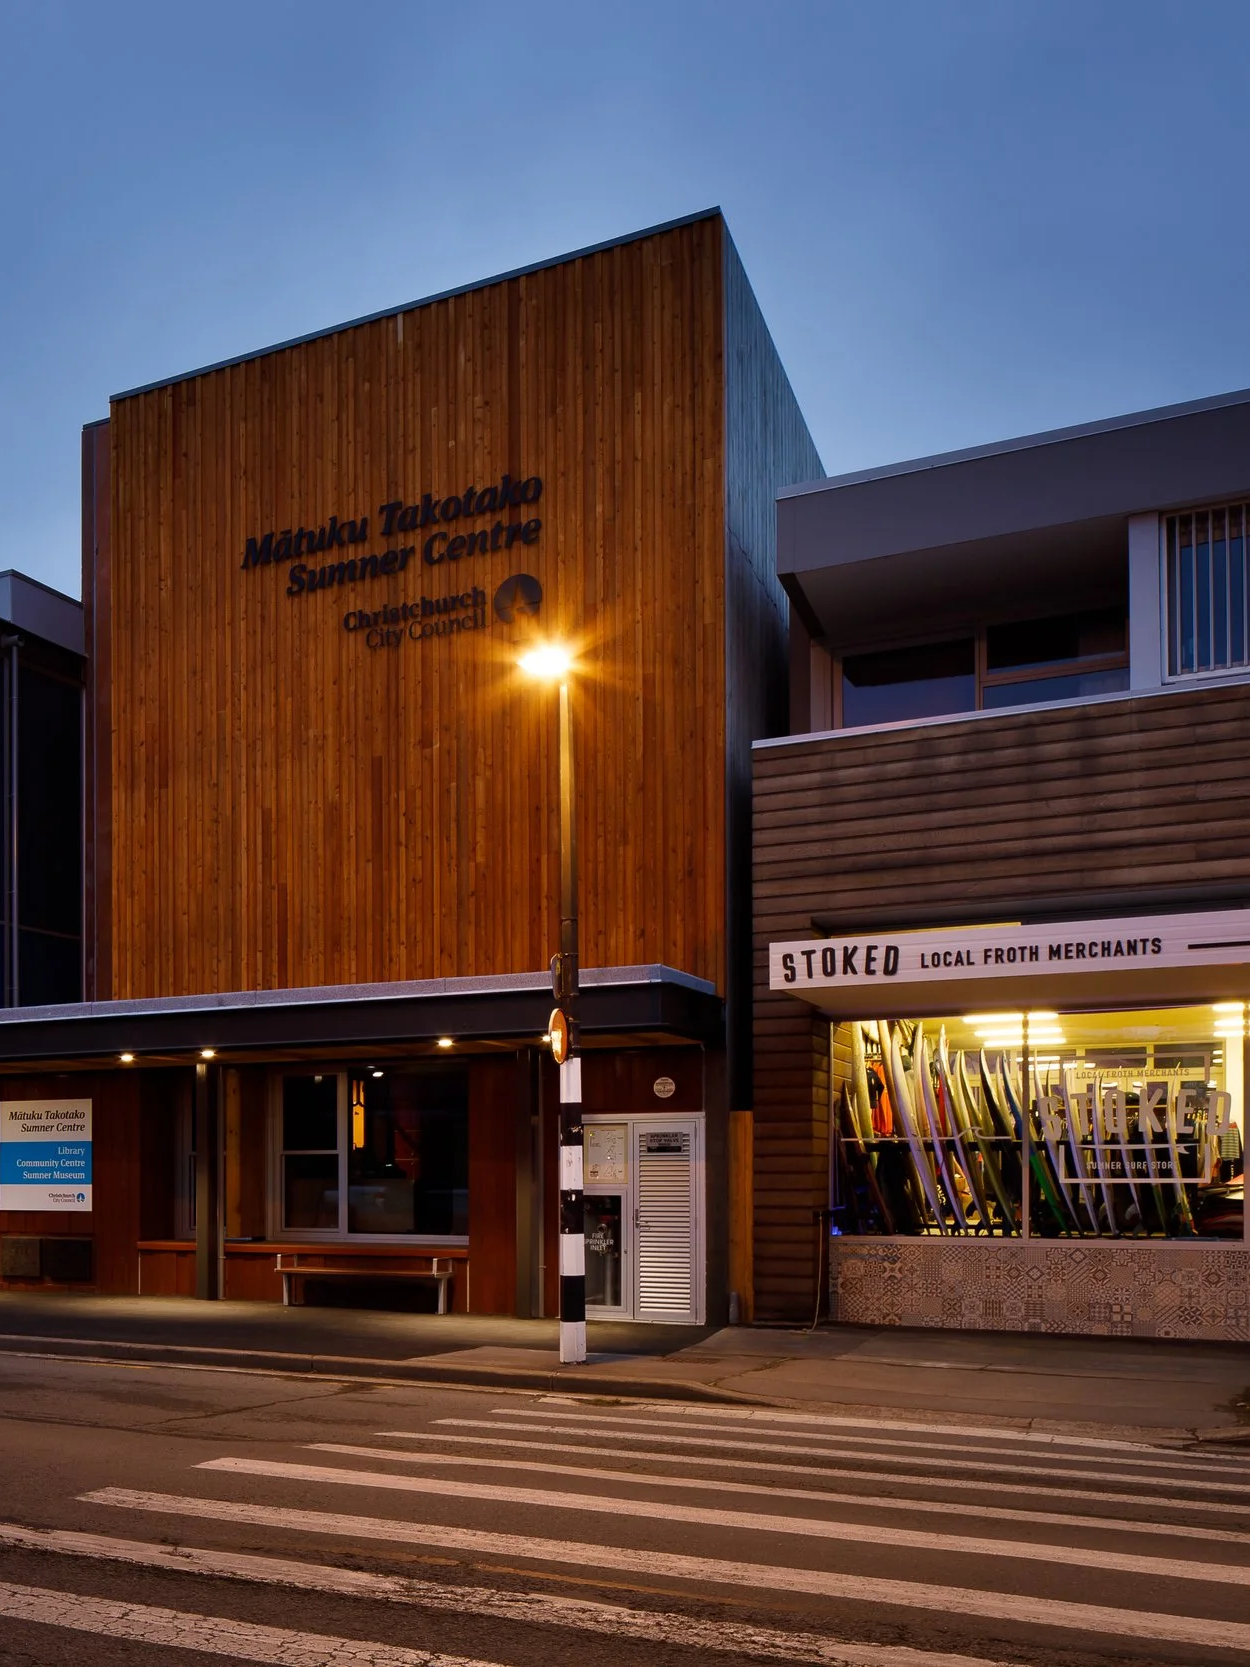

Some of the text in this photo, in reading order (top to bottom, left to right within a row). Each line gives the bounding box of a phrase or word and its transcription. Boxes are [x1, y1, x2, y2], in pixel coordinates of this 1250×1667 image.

[240, 474, 543, 570] Mātuku Takotako
[286, 517, 542, 597] Sumner Centre
[343, 585, 488, 632] Christchurch
[365, 606, 487, 650] City Council
[781, 937, 1163, 983] STOKED LOCAL FROTH MERCHANTS
[1076, 1068, 1191, 1079] LOCAL FROTH MERCHANTS
[8, 1109, 86, 1121] Mātuku Takotako
[1042, 1088, 1232, 1140] STOKED
[20, 1122, 86, 1133] Sumner Centre
[57, 1146, 86, 1157] Library
[16, 1158, 86, 1169] Community Centre
[1085, 1161, 1122, 1170] SUMNER
[1124, 1161, 1148, 1170] SURF
[22, 1170, 86, 1179] Sumner Museum
[584, 1238, 615, 1246] PRINKLER
